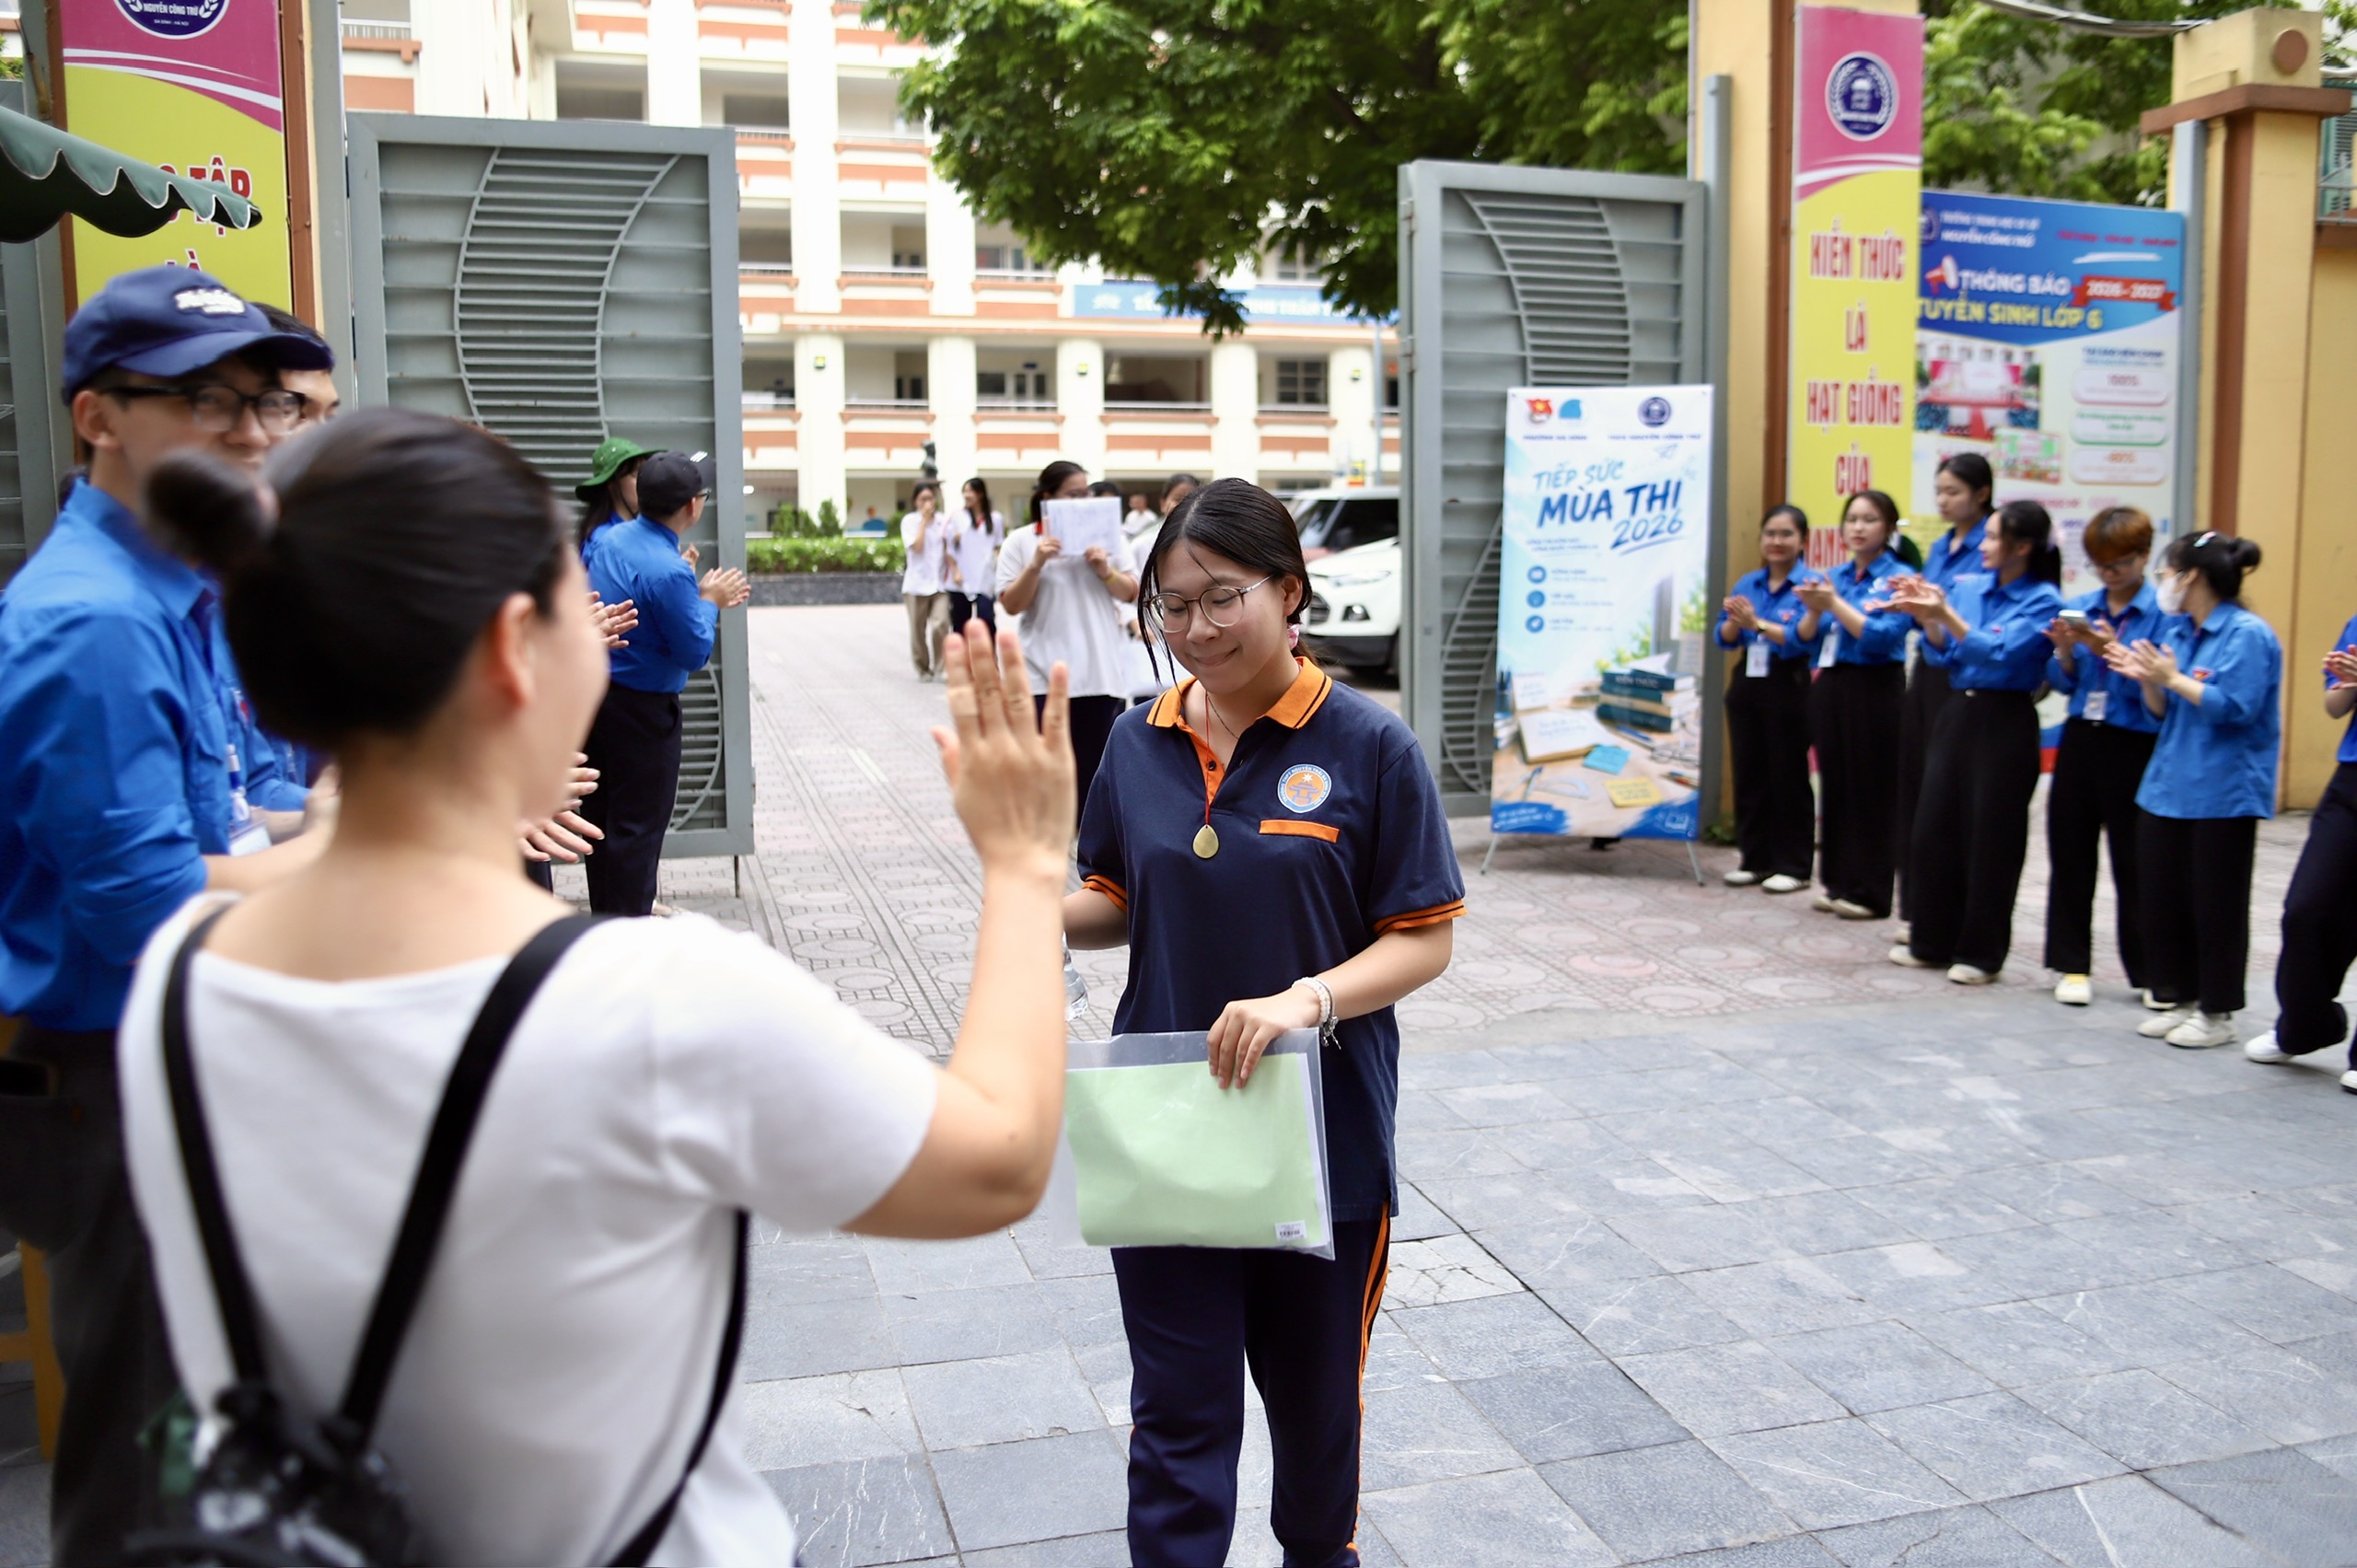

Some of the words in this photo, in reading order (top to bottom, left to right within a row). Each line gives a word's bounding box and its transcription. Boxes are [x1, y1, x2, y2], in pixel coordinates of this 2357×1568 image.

[144, 1, 168, 14] NGUYỄN
[168, 4, 186, 15] CÔNG
[1809, 217, 1852, 279] KIẾN
[1859, 229, 1904, 282] THỨC
[1959, 269, 2025, 294] THÔNG
[2028, 272, 2071, 296] BÁO
[1845, 301, 1866, 352] LÀ
[1917, 290, 1986, 322] TUYỂN
[1989, 302, 2039, 326] SINH
[2042, 302, 2084, 329] LỚP
[2086, 308, 2103, 330] 6
[1807, 381, 1840, 433] HẠT
[1847, 366, 1903, 425] GIỐNG
[1533, 462, 1577, 490] TIẾP
[1585, 458, 1624, 484] SỨC
[1835, 442, 1870, 496] CỦA
[1537, 485, 1613, 528] MÙA
[1624, 479, 1682, 517] THI
[1610, 509, 1684, 550] 2026
[1291, 765, 1313, 773] NGUYỄN
